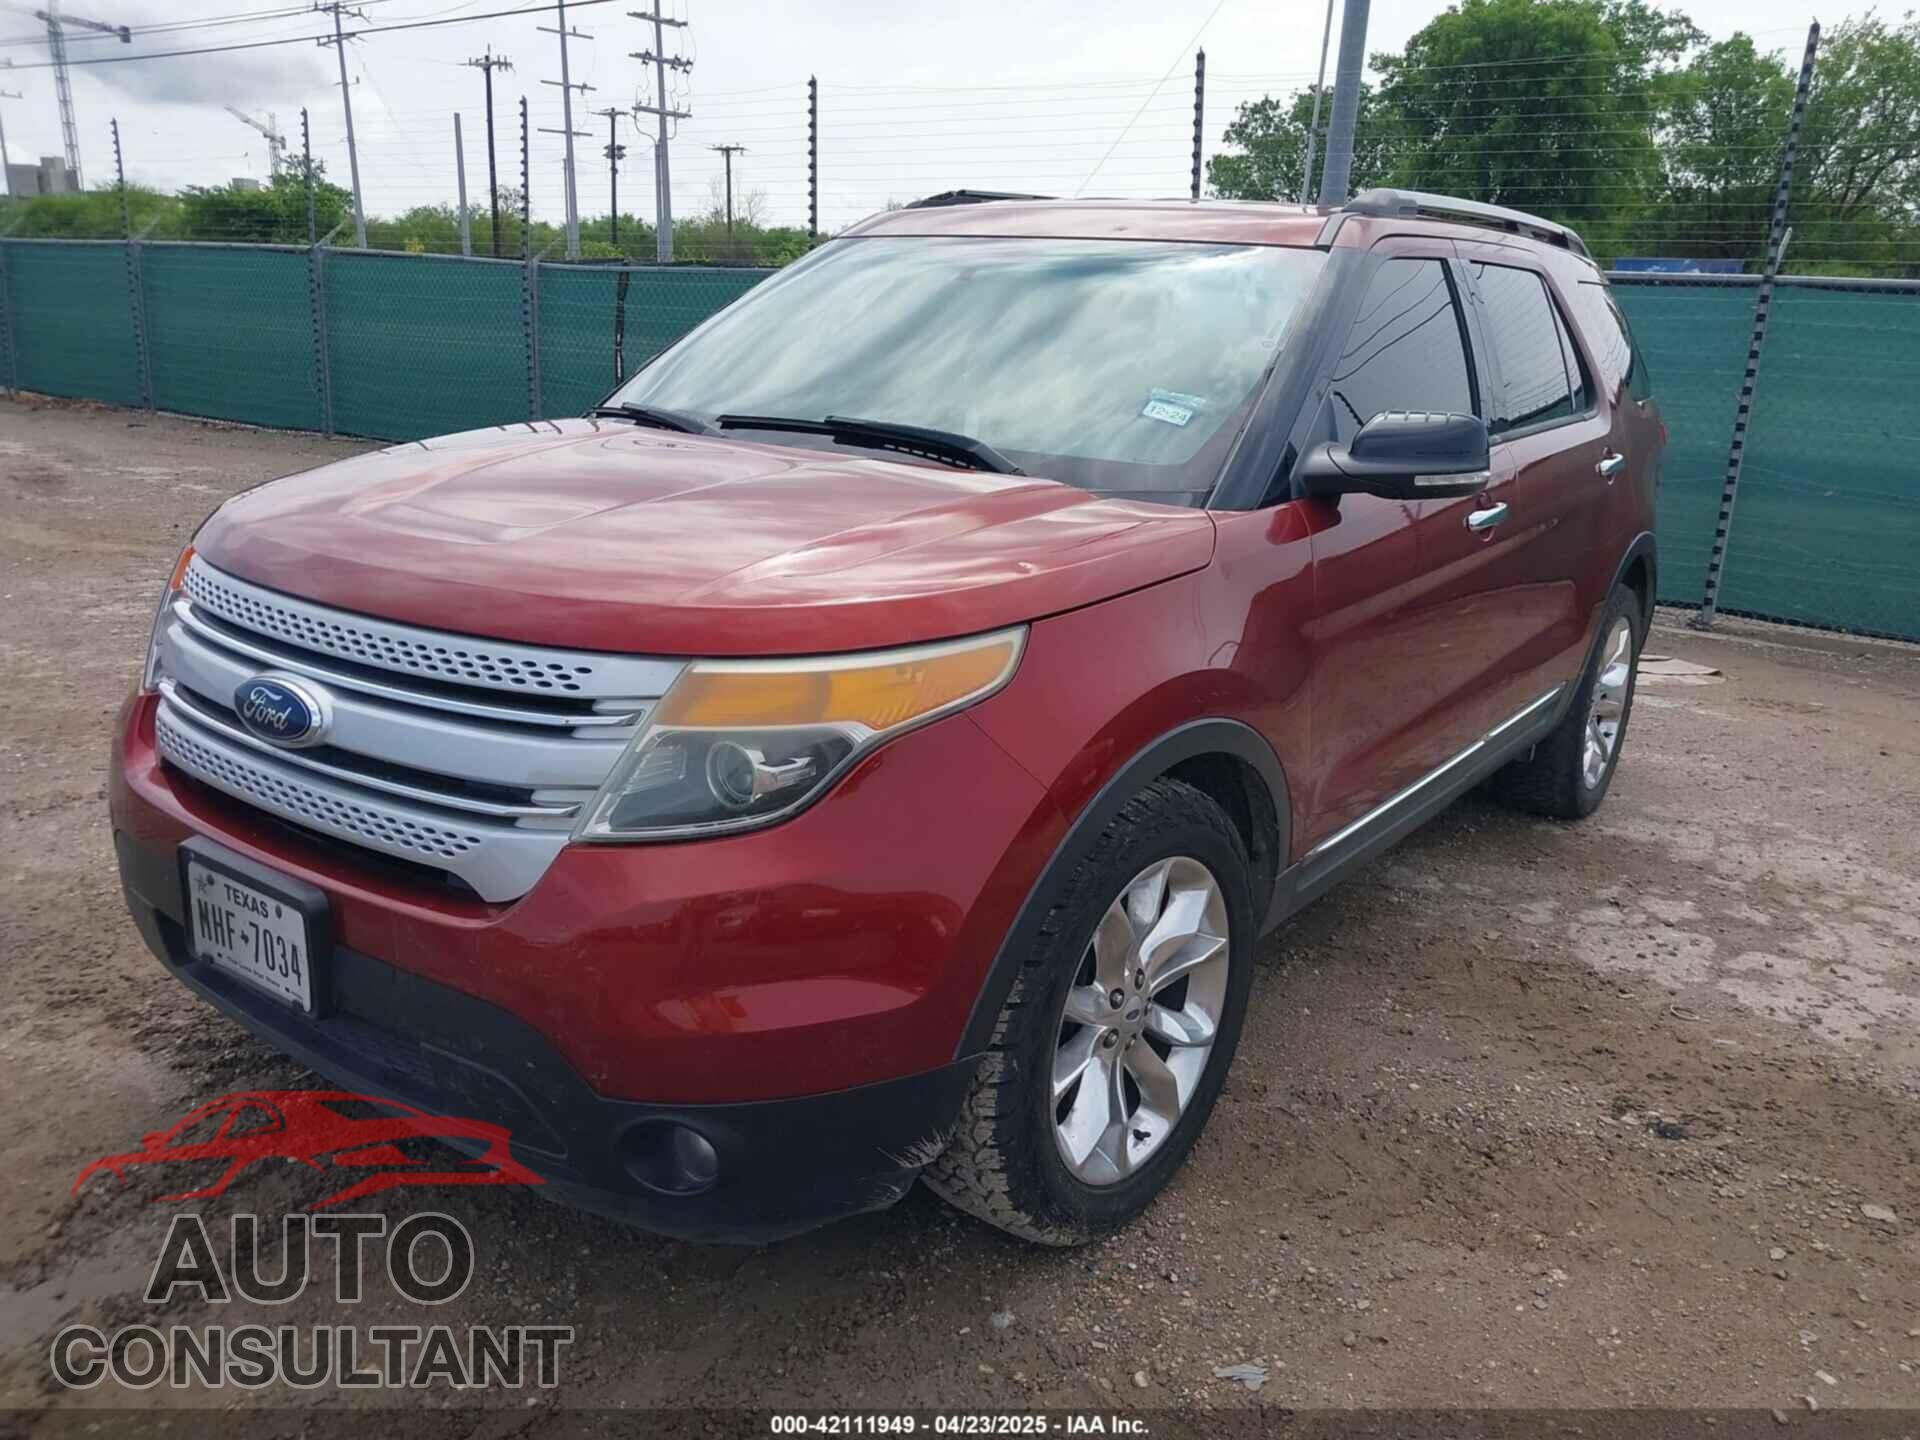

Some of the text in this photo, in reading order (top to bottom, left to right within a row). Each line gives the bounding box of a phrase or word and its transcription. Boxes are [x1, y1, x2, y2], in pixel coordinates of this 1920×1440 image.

[243, 686, 292, 731] Ford
[223, 883, 269, 919] TEXAS
[248, 921, 302, 987] 7034
